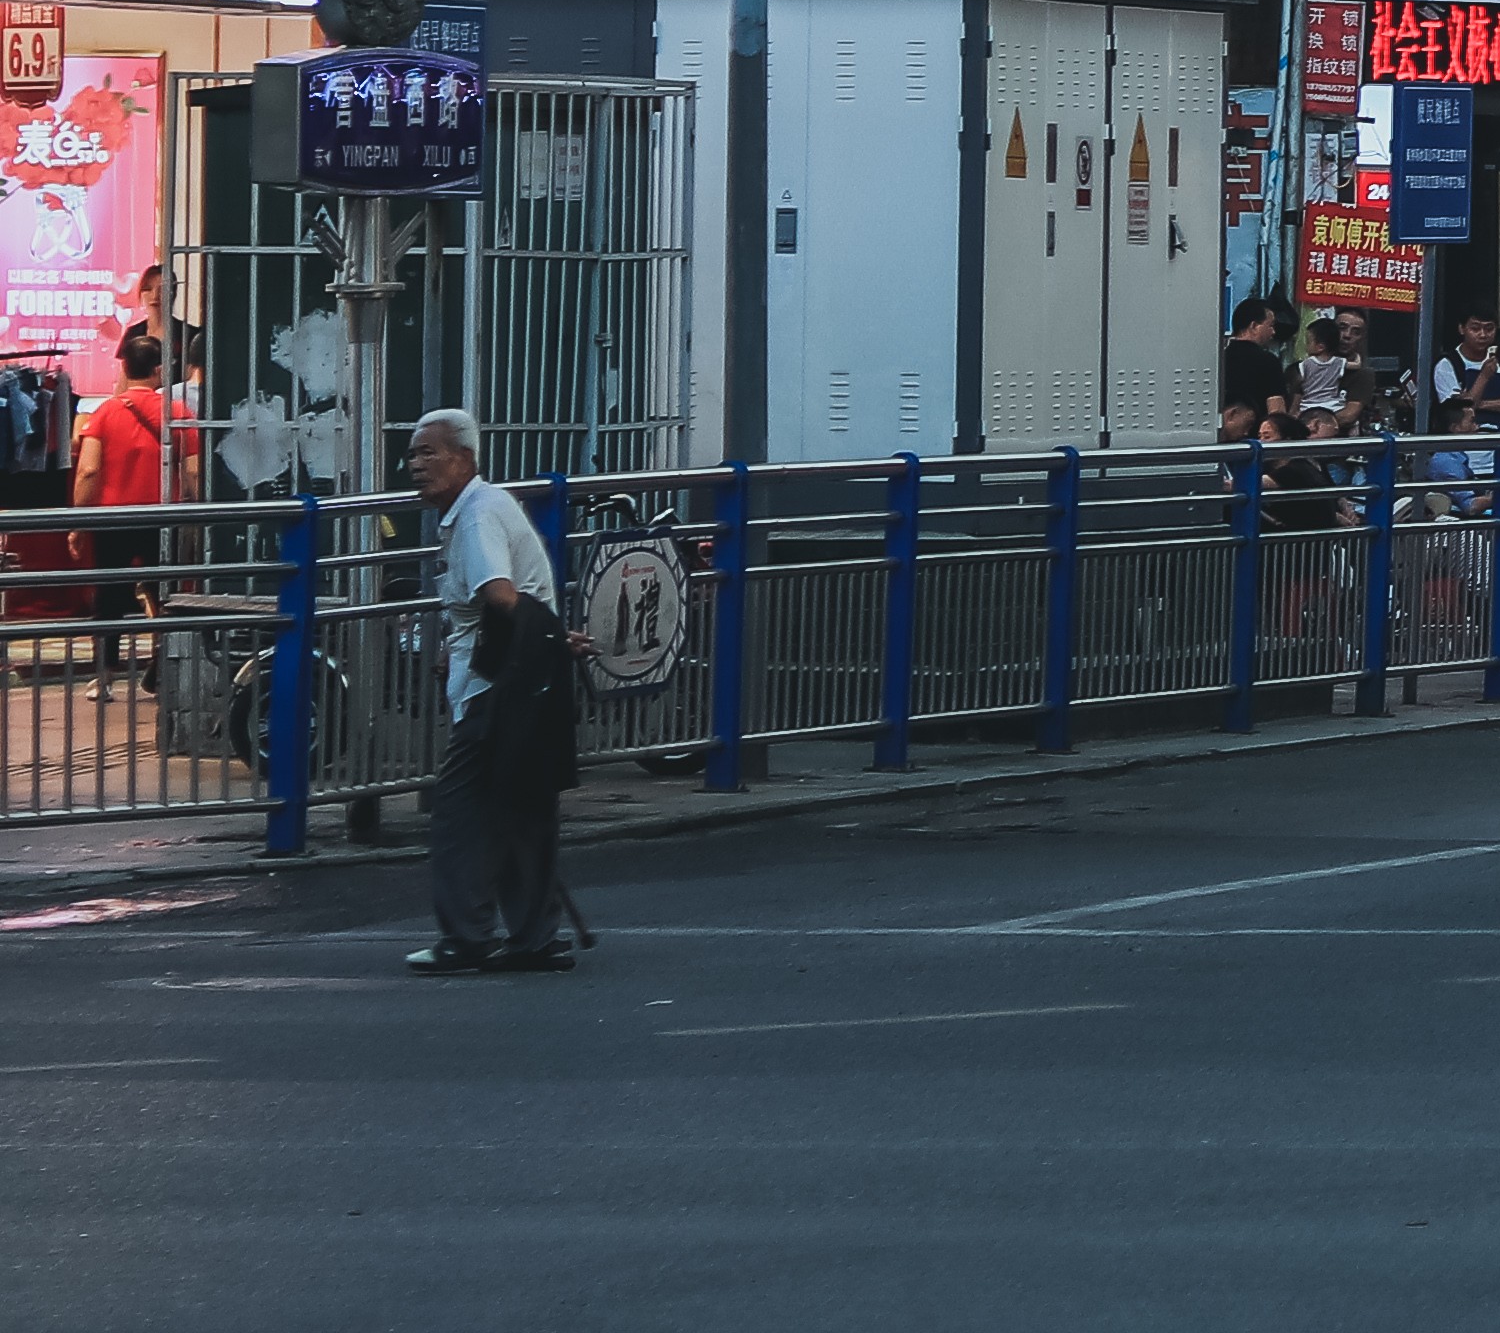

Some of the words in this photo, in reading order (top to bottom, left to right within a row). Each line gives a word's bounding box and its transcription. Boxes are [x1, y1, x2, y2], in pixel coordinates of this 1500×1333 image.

[1308, 7, 1360, 27] 开锁
[1306, 57, 1357, 77] 指纹锁
[342, 145, 399, 167] YINGPAN
[422, 145, 451, 167] XILU
[1311, 213, 1424, 256] 袁师傅开锁心
[6, 290, 116, 318] FOREVER
